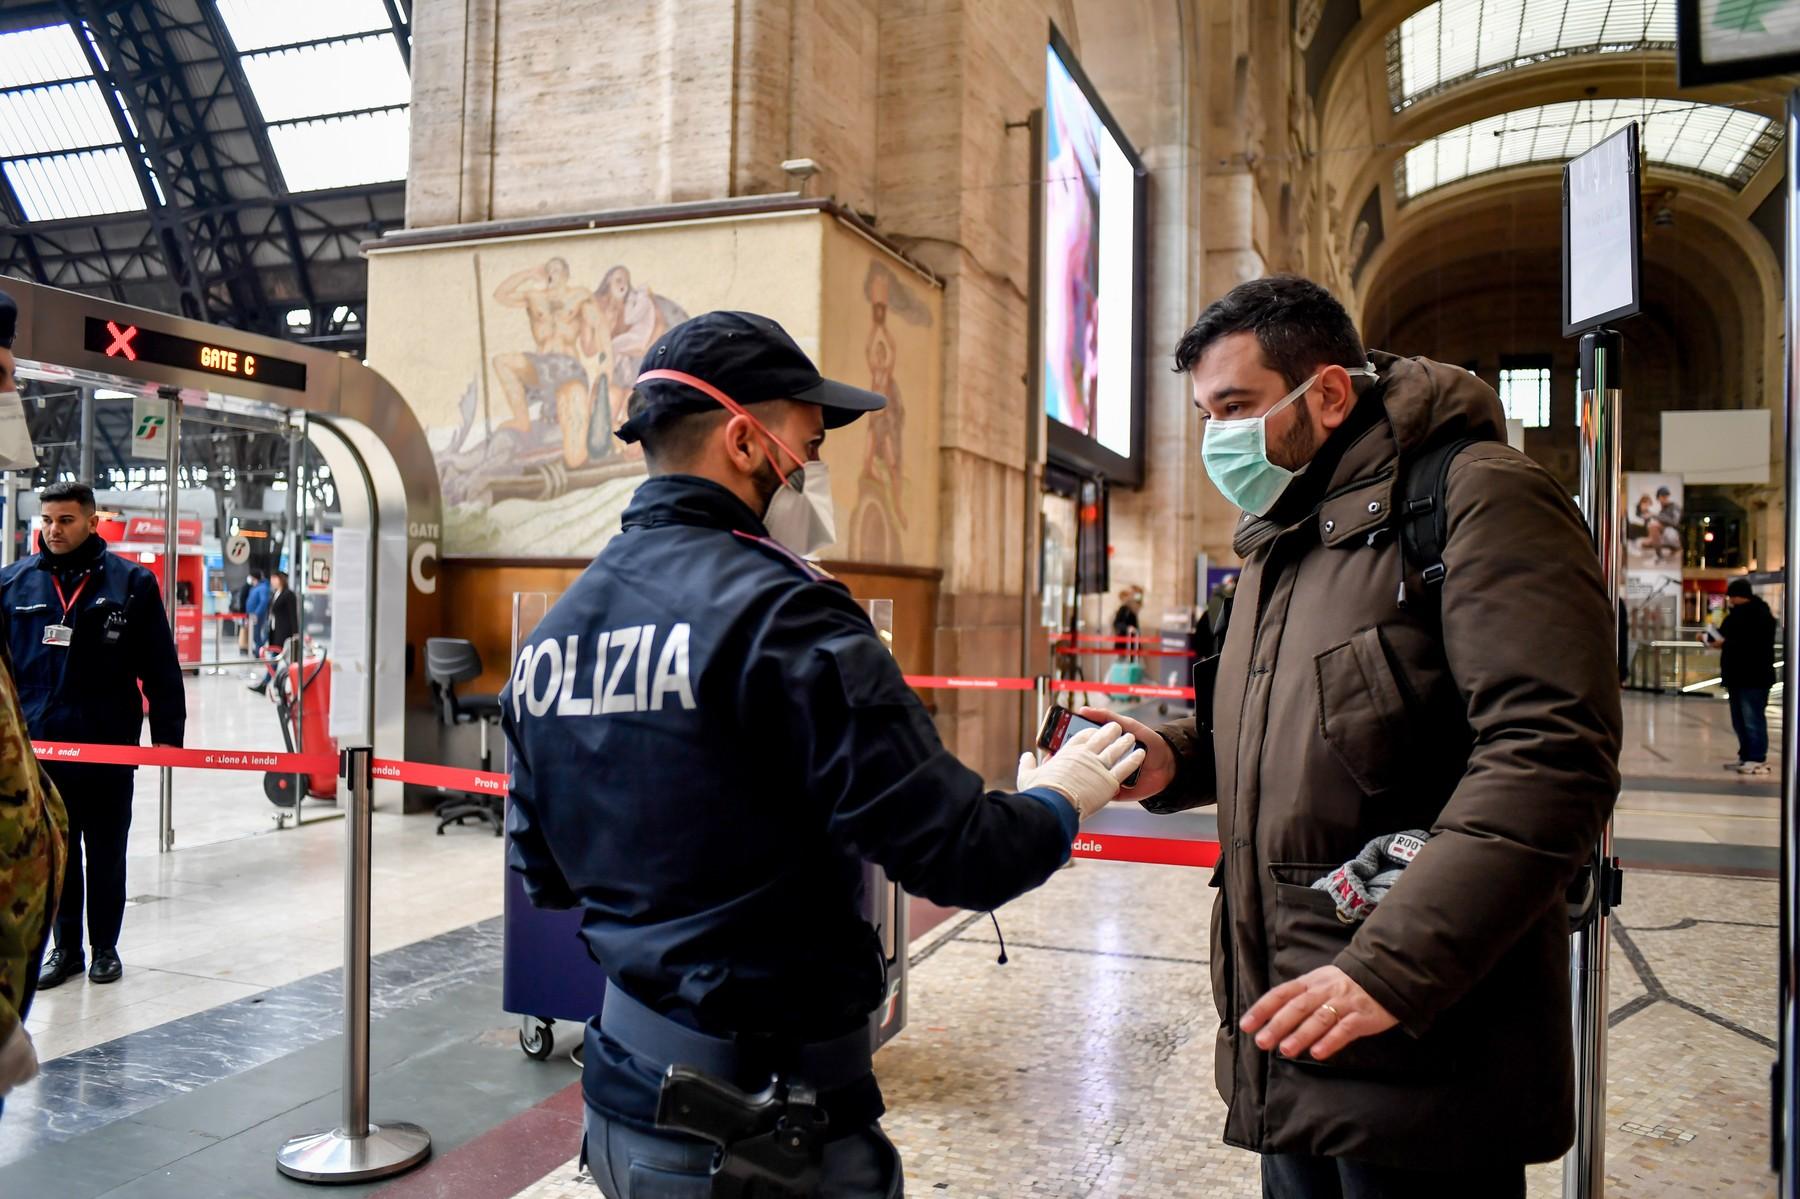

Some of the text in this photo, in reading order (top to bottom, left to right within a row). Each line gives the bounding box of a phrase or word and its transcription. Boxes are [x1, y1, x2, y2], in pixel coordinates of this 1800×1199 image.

[201, 346, 255, 376] GATE C
[409, 522, 440, 539] GATE
[411, 541, 437, 595] C
[512, 622, 697, 723] POLIZIA
[1071, 839, 1103, 852] dale
[1396, 836, 1424, 851] ROO
